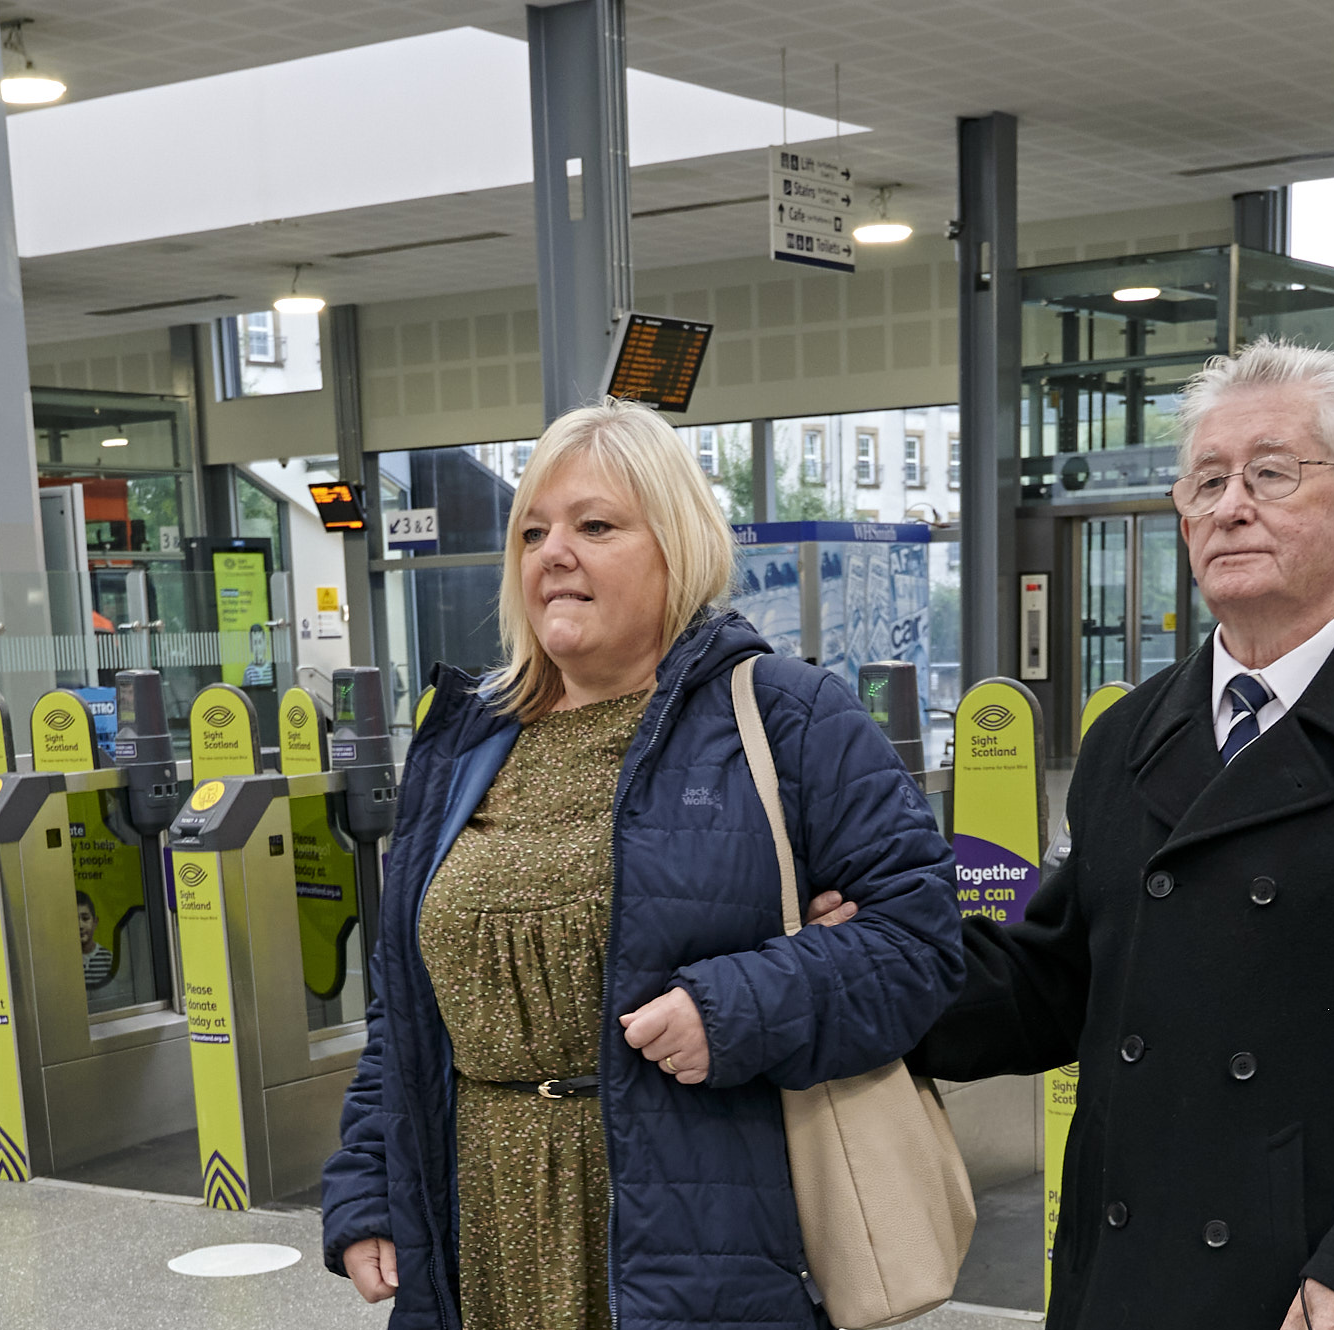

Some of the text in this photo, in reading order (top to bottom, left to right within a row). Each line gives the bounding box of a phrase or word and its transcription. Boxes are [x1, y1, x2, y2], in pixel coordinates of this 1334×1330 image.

[794, 181, 816, 199] Stairs
[816, 238, 841, 255] Toilets
[403, 516, 434, 534] 3 & 2
[44, 734, 63, 745] Sight
[203, 731, 223, 742] Sight
[971, 736, 998, 748] Sight
[45, 743, 78, 752] Scotland
[204, 740, 239, 750] Scotland
[971, 746, 1017, 758] Scotland
[682, 786, 709, 797] Jack
[93, 839, 116, 853] help
[79, 854, 113, 867] people
[956, 863, 1029, 886] Together
[180, 890, 195, 901] Sight
[957, 888, 1015, 901] we can
[180, 901, 212, 911] Scotland
[961, 905, 1007, 922] ackle
[214, 1017, 226, 1027] at
[1052, 1079, 1077, 1094] Sight
[1052, 1093, 1077, 1105] Scotl
